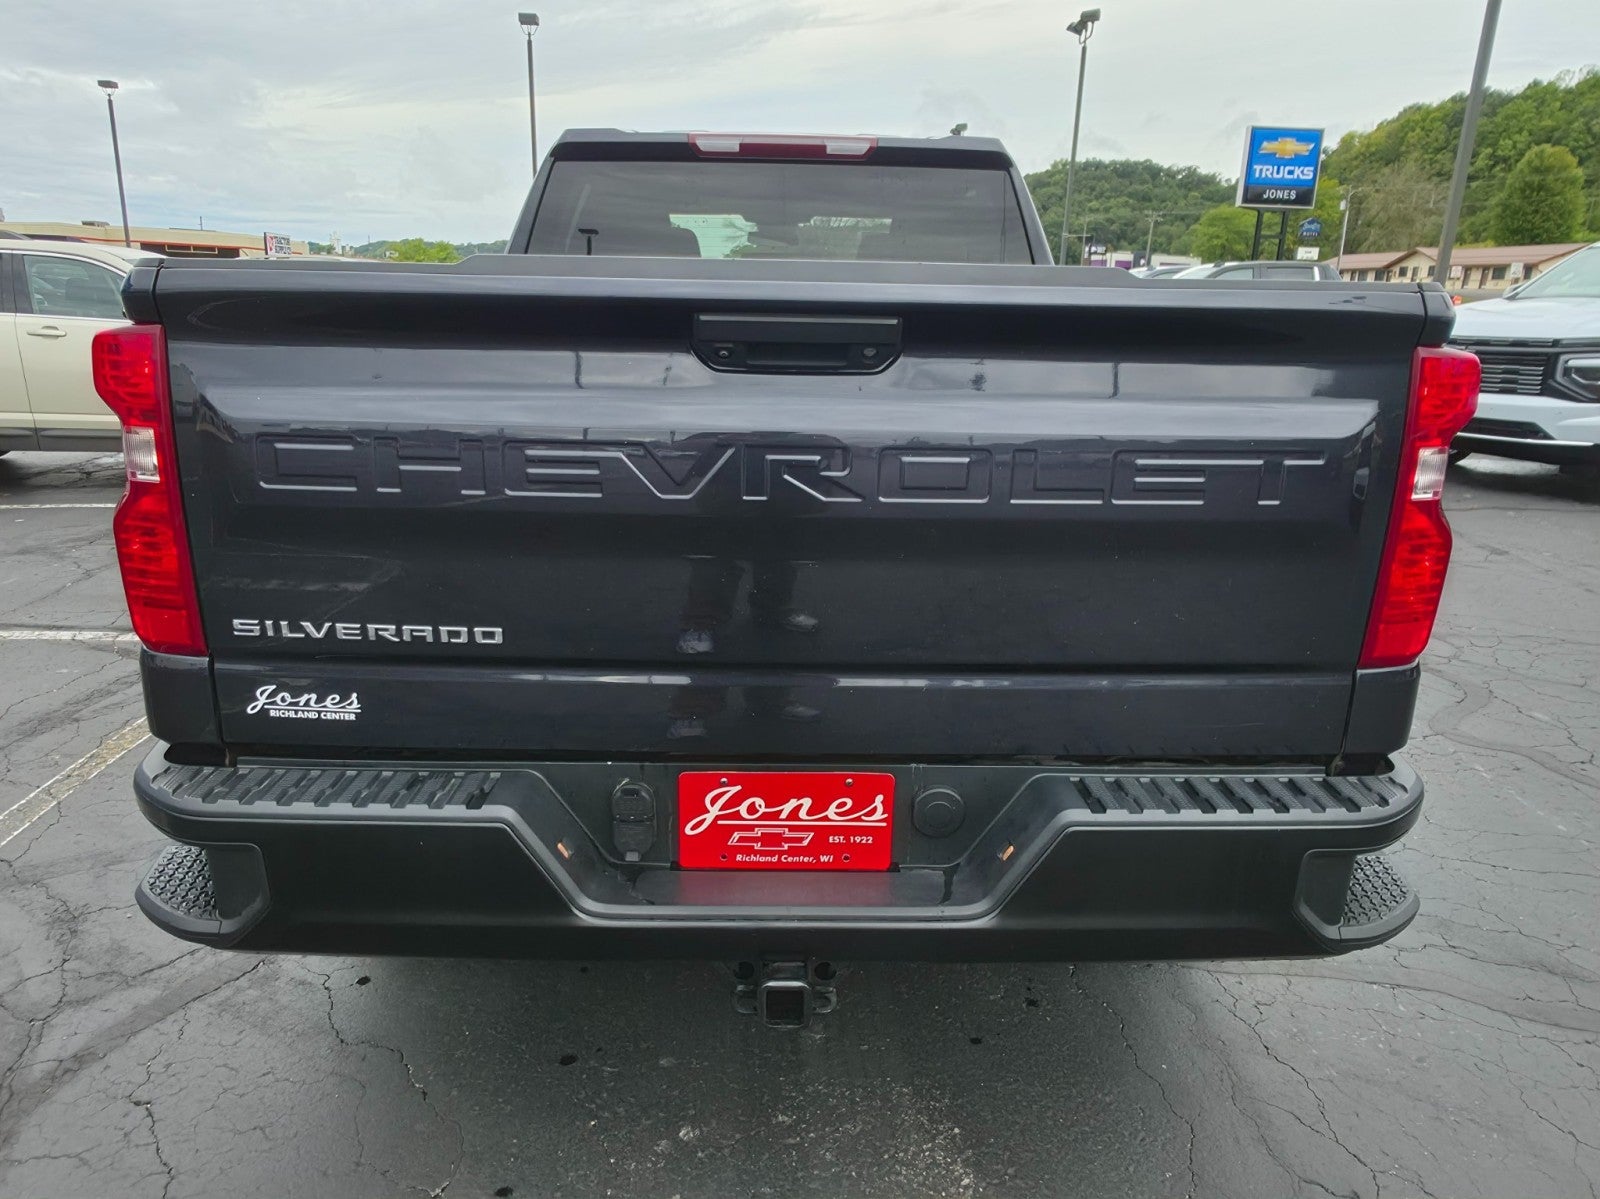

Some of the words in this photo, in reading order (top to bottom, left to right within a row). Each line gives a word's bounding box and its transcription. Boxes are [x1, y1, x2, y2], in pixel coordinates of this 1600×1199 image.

[1253, 165, 1314, 180] TRUCKS
[1263, 189, 1296, 200] JONES
[255, 433, 1325, 506] CHEVROLET
[232, 619, 503, 644] SILVERADO
[247, 685, 361, 714] Jones
[270, 709, 319, 718] RICHLAND
[321, 712, 356, 720] CENTER
[684, 785, 888, 835] Jones
[850, 836, 873, 844] 1922
[736, 853, 778, 862] Richland
[781, 854, 816, 863] Center,
[820, 854, 834, 862] WI
